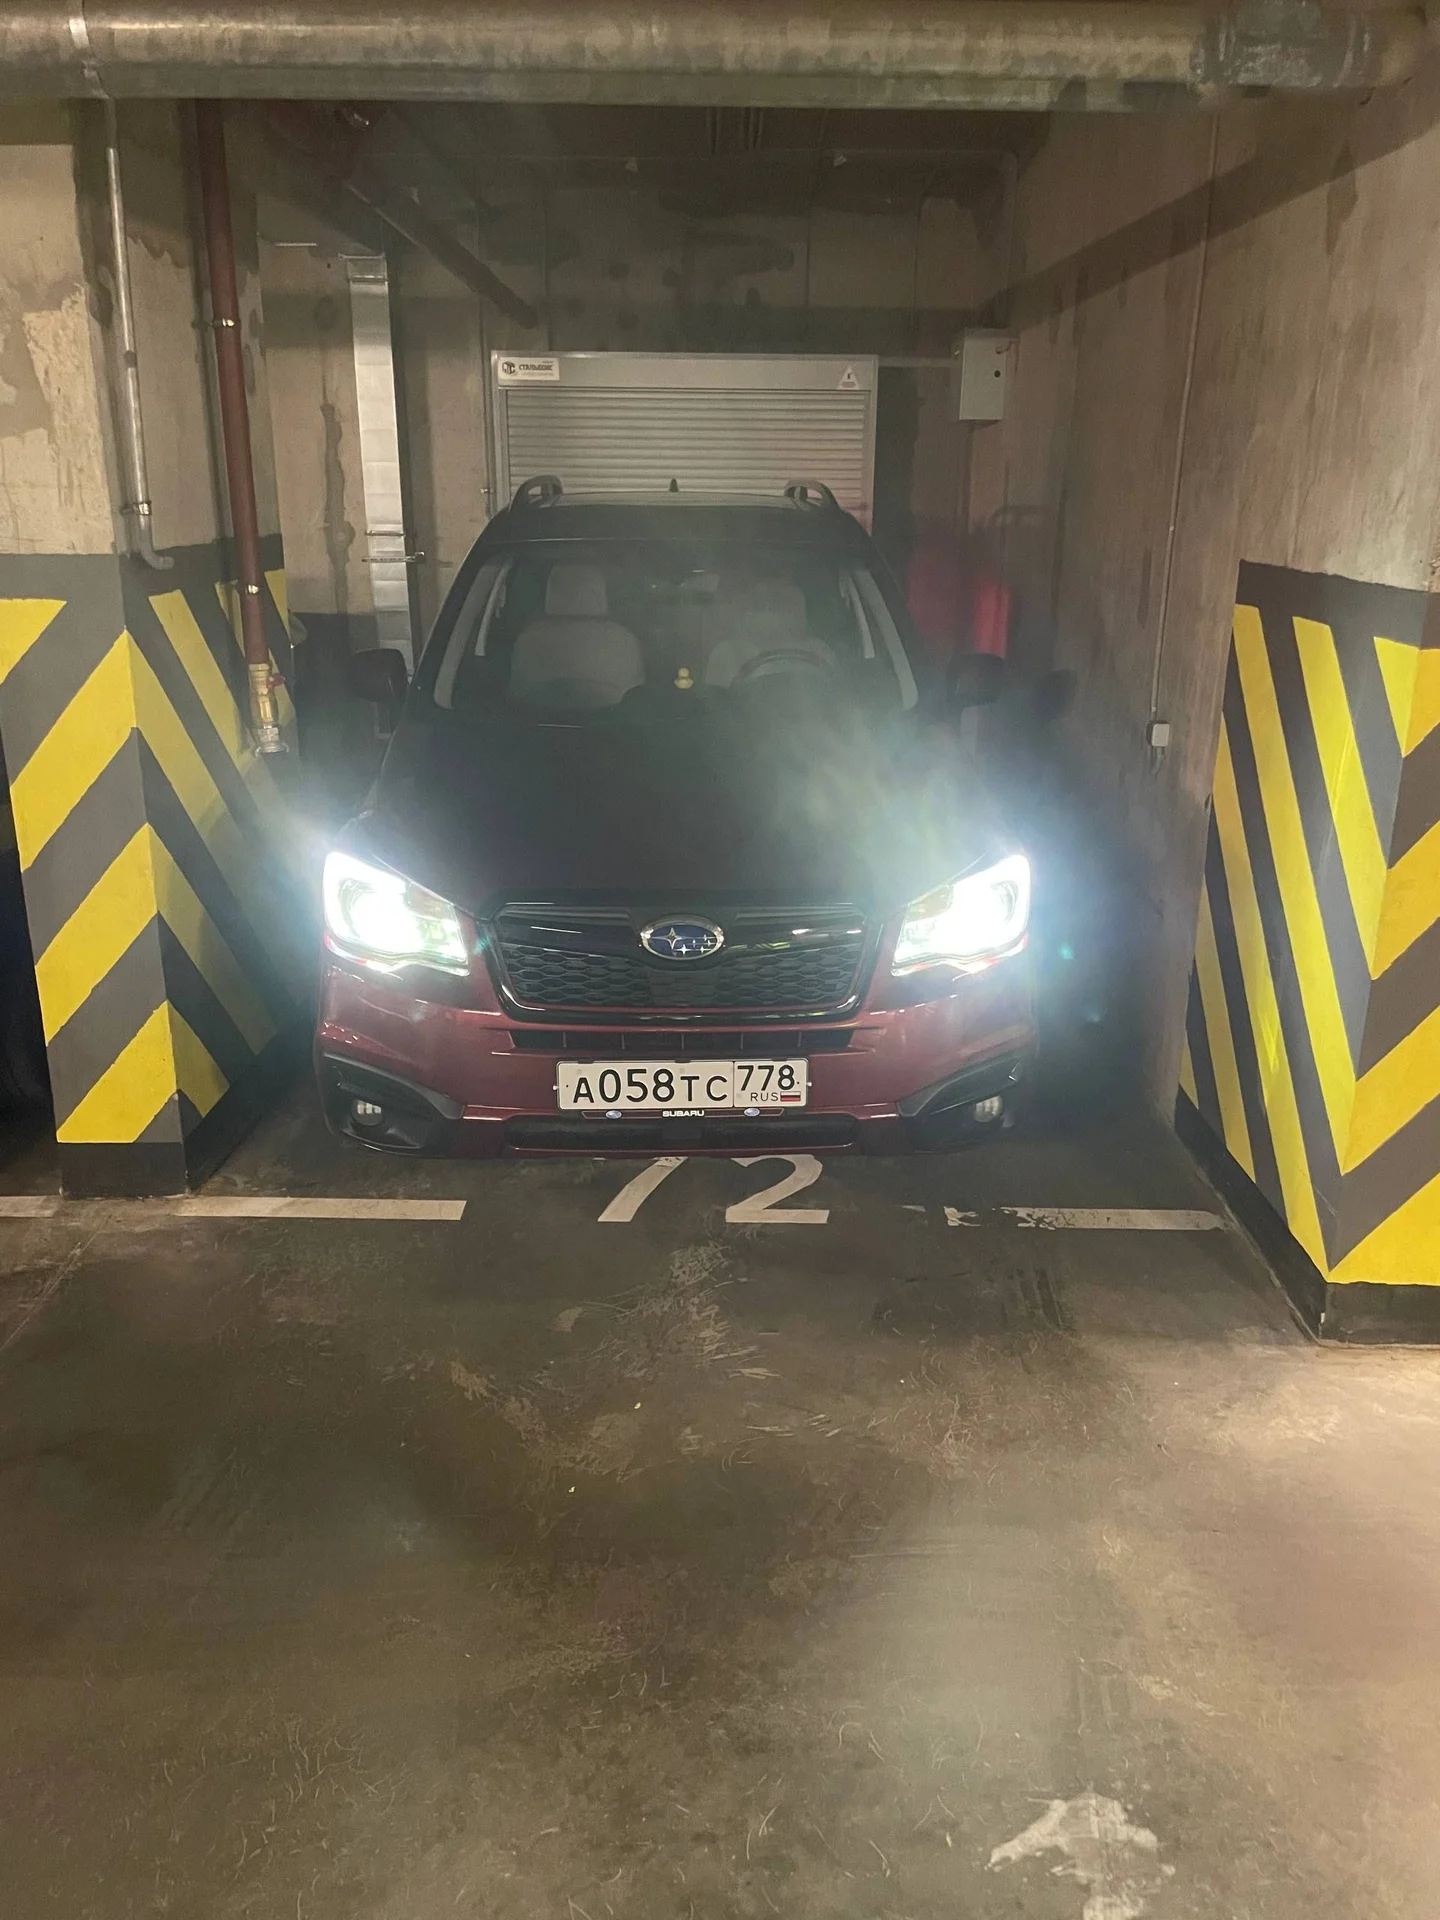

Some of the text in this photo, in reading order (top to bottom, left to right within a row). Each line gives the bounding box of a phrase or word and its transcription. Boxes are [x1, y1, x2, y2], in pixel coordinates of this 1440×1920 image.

[736, 1064, 795, 1092] 778
[750, 1092, 779, 1102] RUS
[662, 1110, 705, 1118] SUBARU
